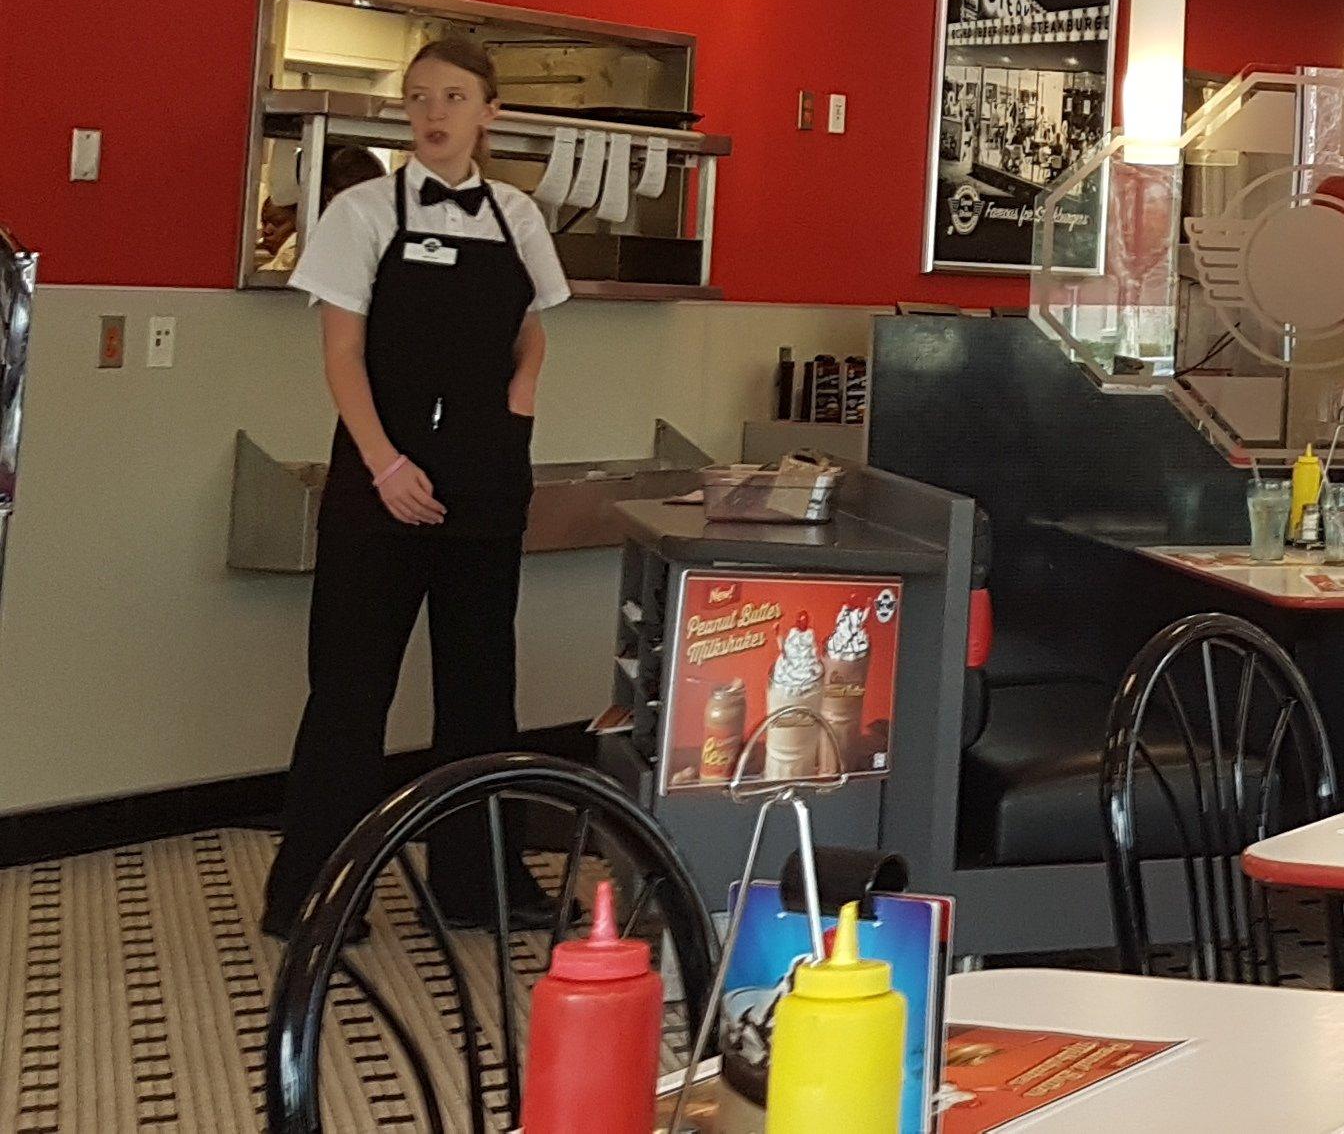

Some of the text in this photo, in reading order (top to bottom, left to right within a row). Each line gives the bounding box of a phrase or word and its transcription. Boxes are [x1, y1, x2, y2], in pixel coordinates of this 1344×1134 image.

[708, 584, 736, 604] New!
[686, 602, 782, 639] Peanut Butter
[686, 630, 766, 666] Milkshakes
